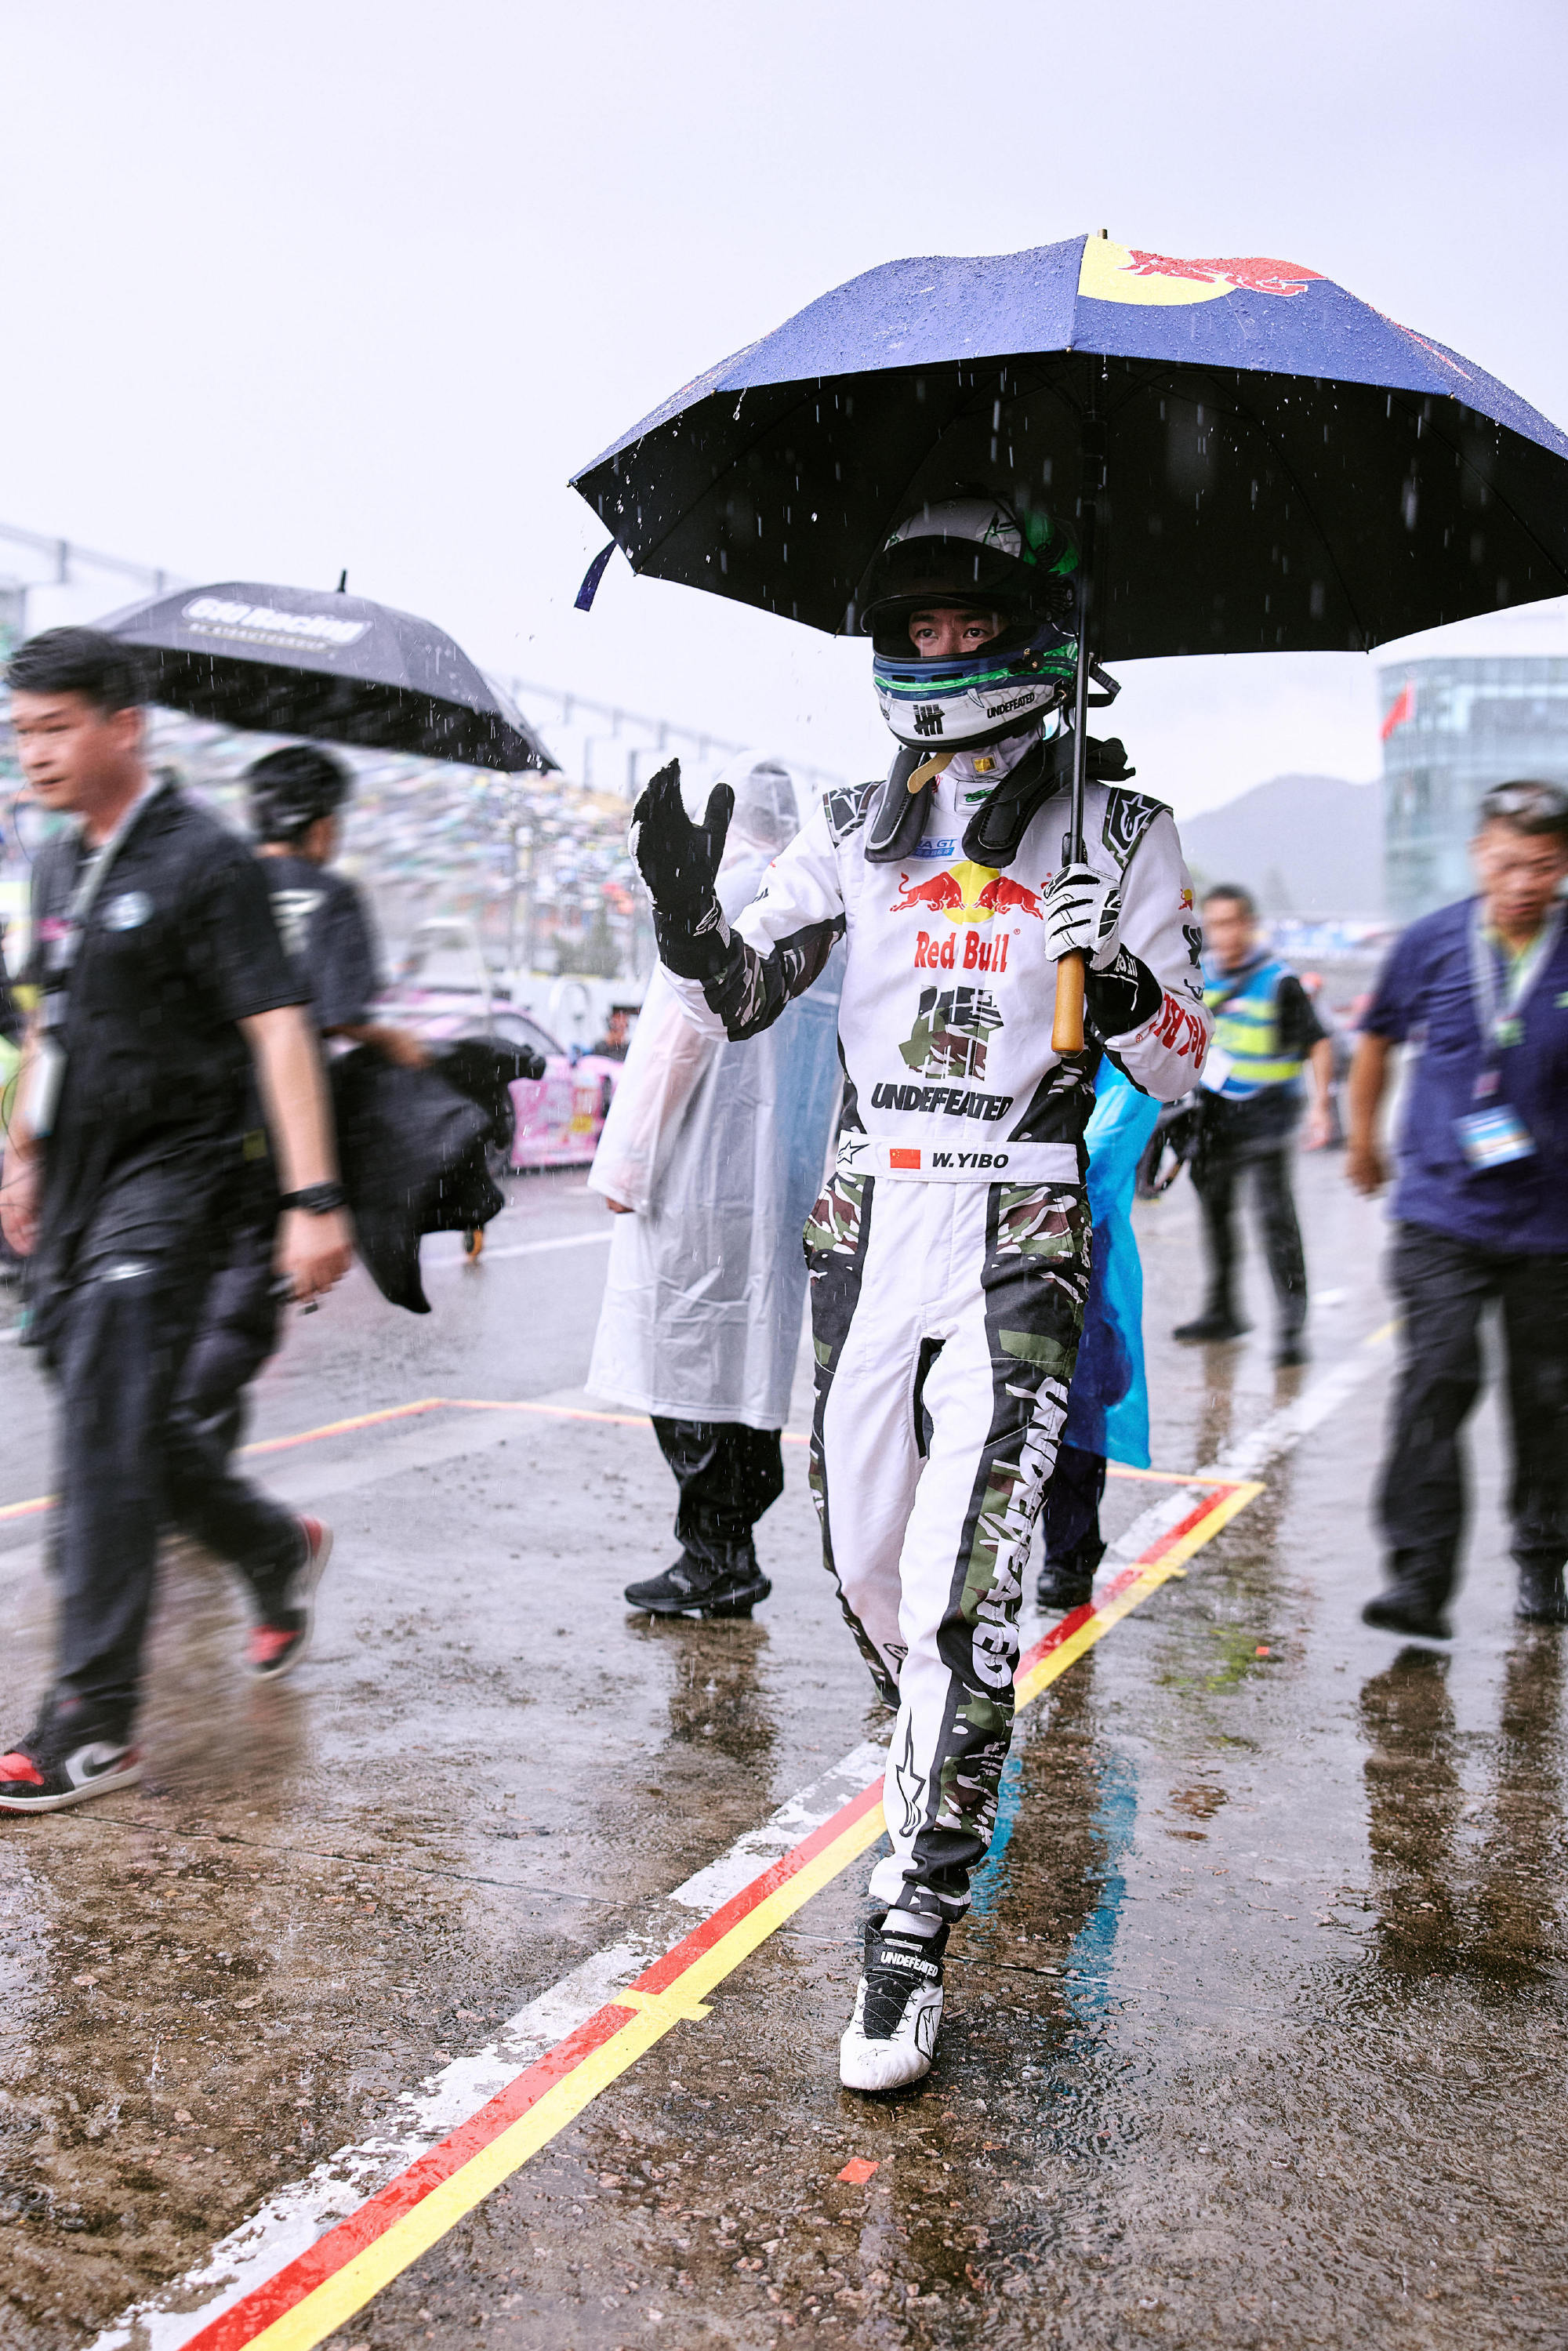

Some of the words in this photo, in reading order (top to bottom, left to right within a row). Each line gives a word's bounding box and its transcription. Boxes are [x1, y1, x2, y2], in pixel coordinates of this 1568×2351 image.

[238, 607, 367, 645] Racing
[987, 692, 1035, 718] UNDEFEATED
[937, 839, 957, 847] GT
[914, 931, 956, 970] Red
[962, 931, 1010, 972] Bull
[871, 1083, 1014, 1121] UNDEFEATED
[932, 1152, 1009, 1168] W.YIBO
[880, 1950, 938, 1977] UNDEFEATED
